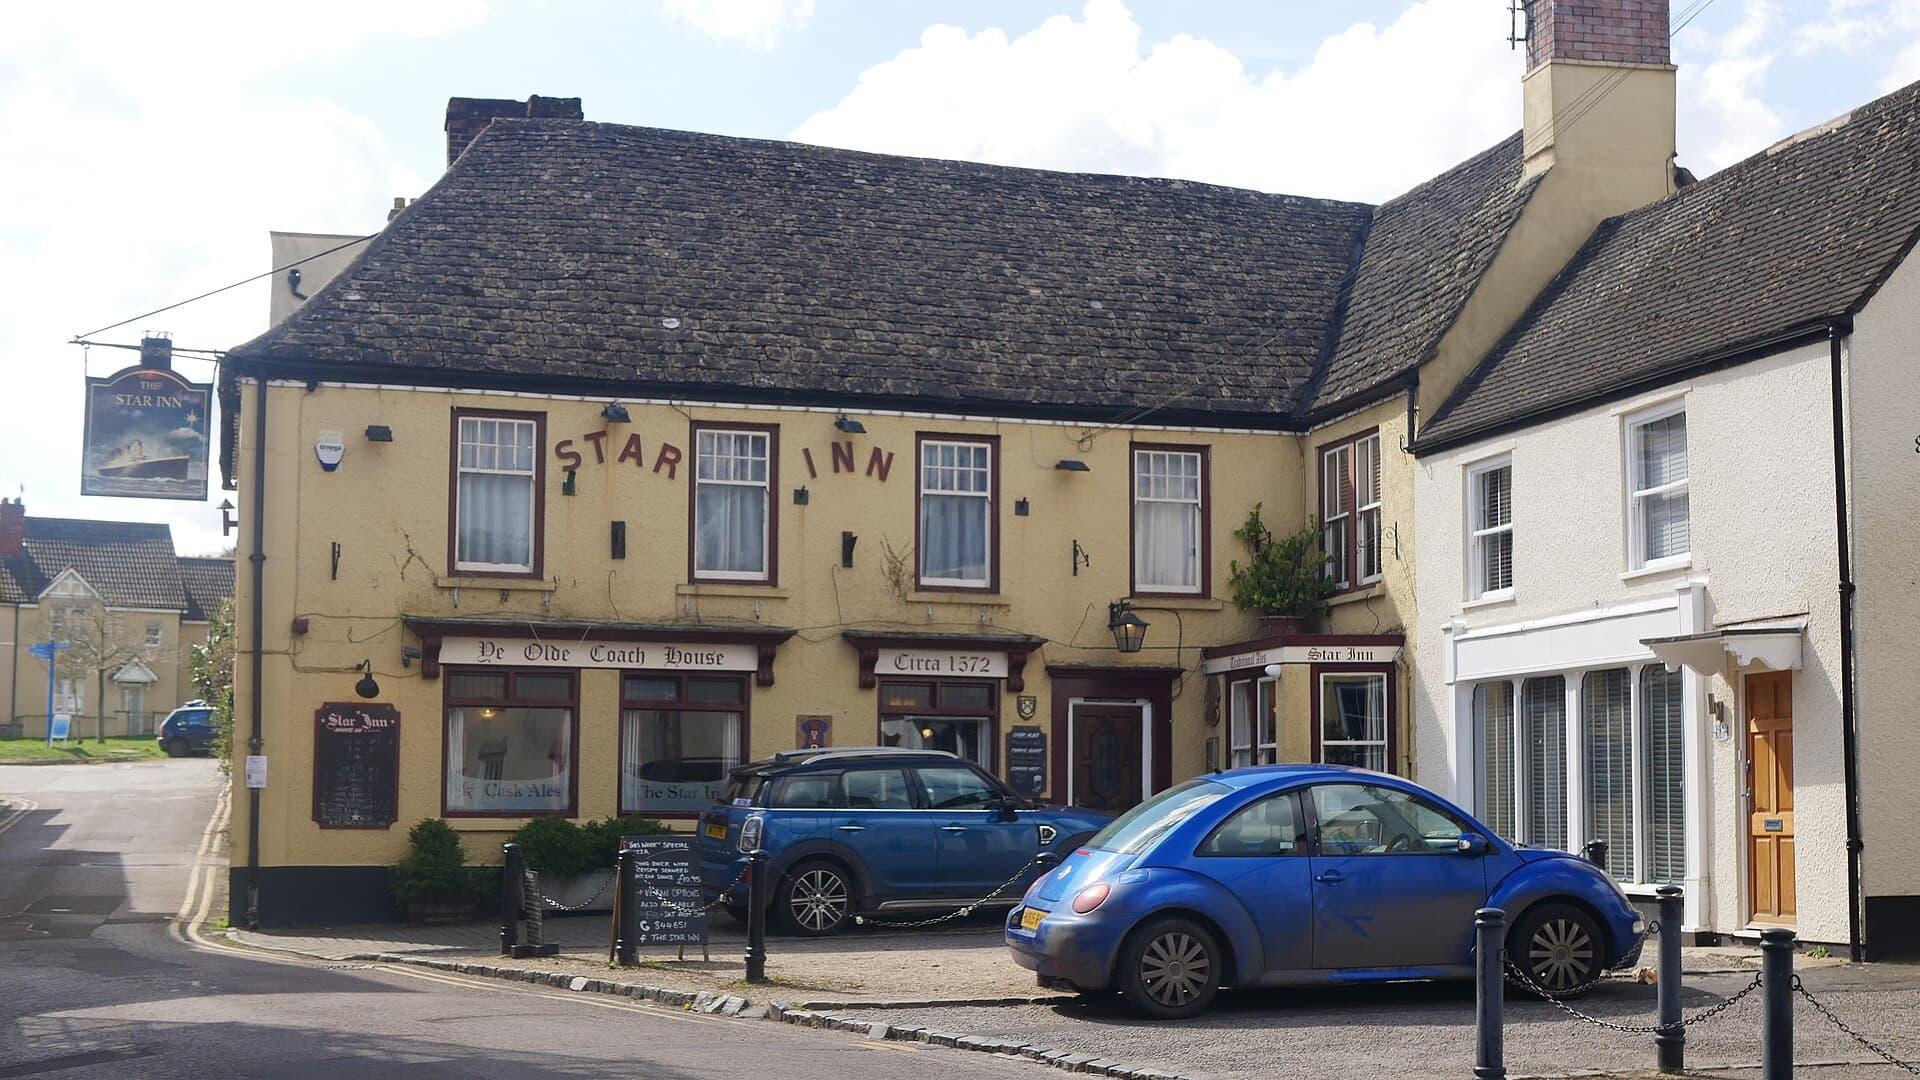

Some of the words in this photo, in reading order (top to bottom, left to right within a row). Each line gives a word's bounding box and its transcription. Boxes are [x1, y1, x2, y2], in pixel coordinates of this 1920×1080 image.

[140, 381, 160, 390] THE
[115, 393, 152, 407] STAR
[156, 394, 182, 408] INN
[554, 431, 682, 480] STAR
[802, 442, 895, 483] INN
[477, 641, 505, 663] Ye
[523, 643, 571, 662] Olde
[589, 645, 646, 665] Coach
[663, 646, 725, 668] House
[1308, 648, 1342, 661] Star
[1345, 647, 1374, 661] Inn
[894, 653, 941, 671] Circa
[948, 656, 991, 673] 1572
[326, 713, 356, 730] Star
[361, 713, 388, 730] Inn
[485, 783, 522, 798] Cask
[527, 783, 562, 798] Ales
[667, 785, 697, 800] Star
[704, 785, 721, 800] In
[654, 920, 687, 930] 844651
[651, 933, 667, 941] THE
[668, 933, 684, 942] STAR
